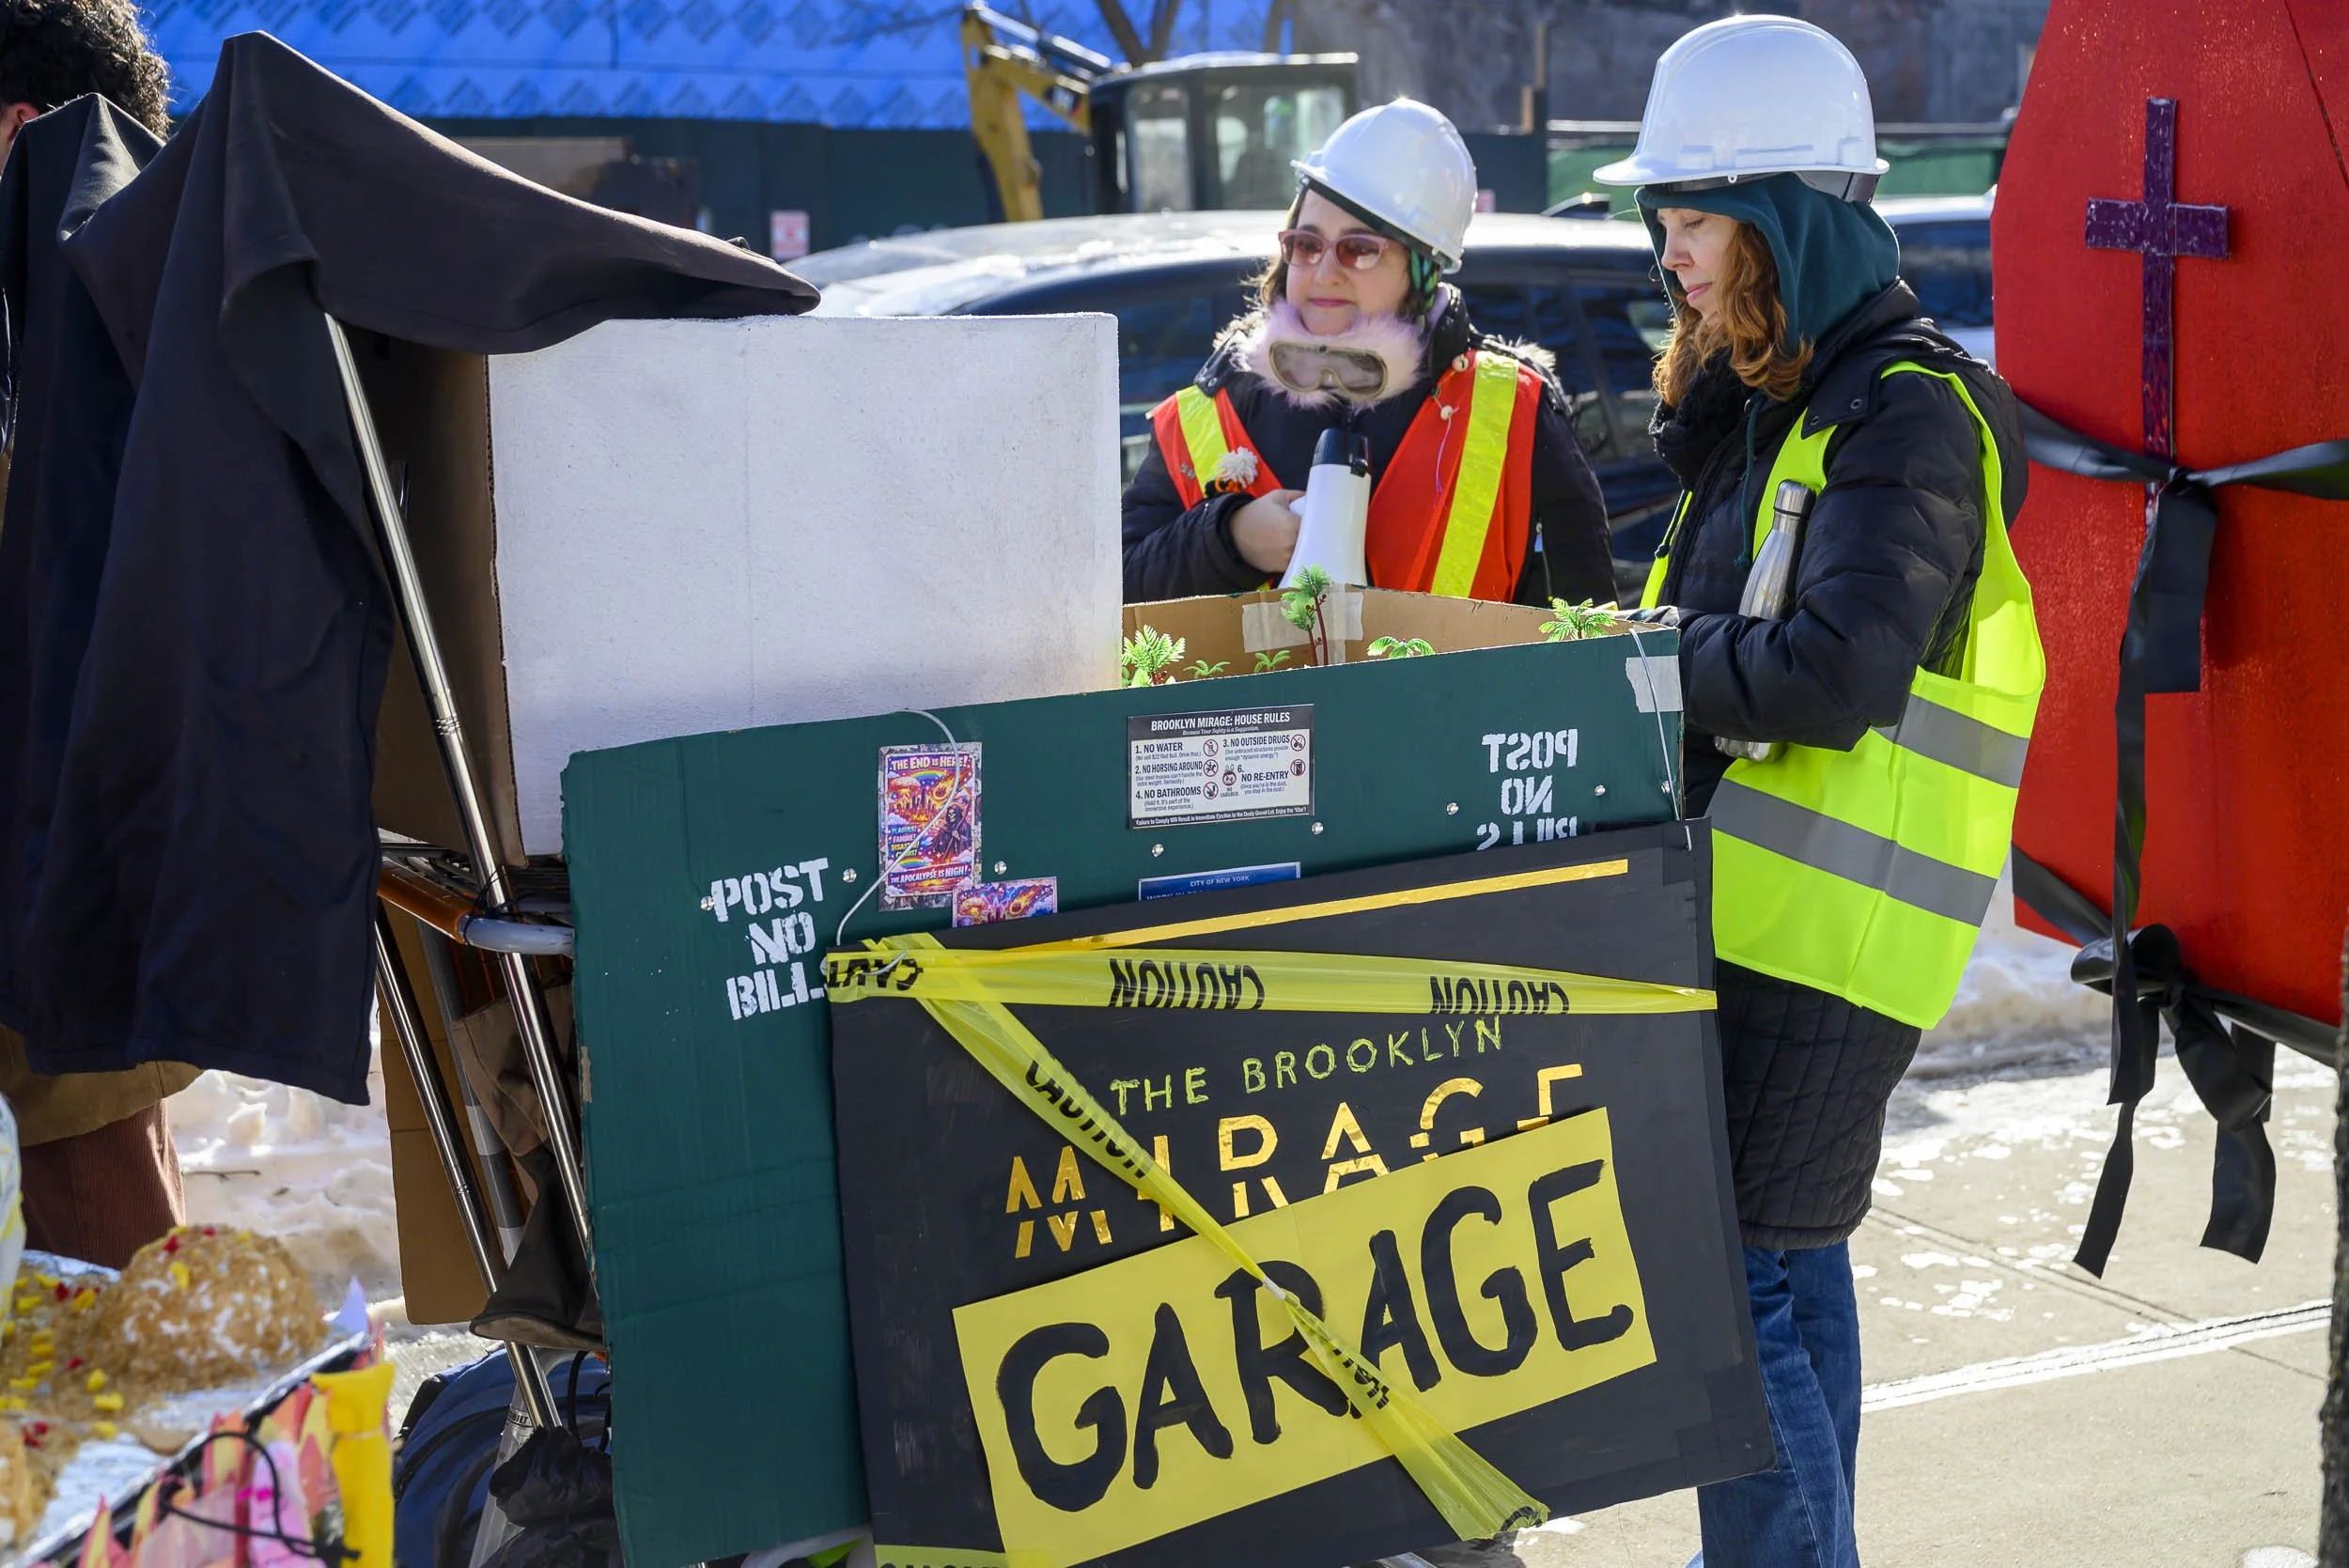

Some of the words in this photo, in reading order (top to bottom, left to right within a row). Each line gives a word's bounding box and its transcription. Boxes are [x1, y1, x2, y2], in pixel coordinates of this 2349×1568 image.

[1151, 719, 1195, 731] BROOKLYN
[1197, 715, 1233, 729] MIRAGE:
[1235, 714, 1263, 725] HOUSE
[1264, 712, 1290, 723] RULES
[1135, 745, 1142, 753] 1.
[1144, 744, 1155, 753] NO
[1157, 742, 1183, 752] WATER
[1231, 738, 1239, 747] NO
[1240, 737, 1267, 746] OUTSIDE
[1268, 735, 1290, 744] DRUGS
[892, 759, 909, 771] THE
[910, 756, 930, 769] END
[932, 758, 940, 767] IS
[1135, 766, 1141, 774] 2.
[1143, 765, 1150, 773] NO
[1152, 762, 1178, 773] HORSING
[1178, 761, 1203, 771] AROUND
[1237, 764, 1244, 773] 6.
[1241, 773, 1252, 782] NO
[1254, 770, 1289, 781] RE-ENTRY
[1135, 790, 1143, 800] 4.
[1144, 789, 1155, 800] NO
[1157, 786, 1202, 798] BATHROOMS
[900, 871, 937, 883] APOCALYPSE
[945, 865, 968, 877] NIGH!
[711, 858, 829, 923] POST
[746, 911, 816, 965] NO
[726, 962, 827, 1020] BILL
[1108, 958, 1265, 1010] CAUTION
[1430, 976, 1569, 1015] CAUTION
[1110, 1067, 1208, 1116] THE
[1242, 1015, 1503, 1094] BROOKLYN
[996, 1158, 1634, 1512] GARAGE
